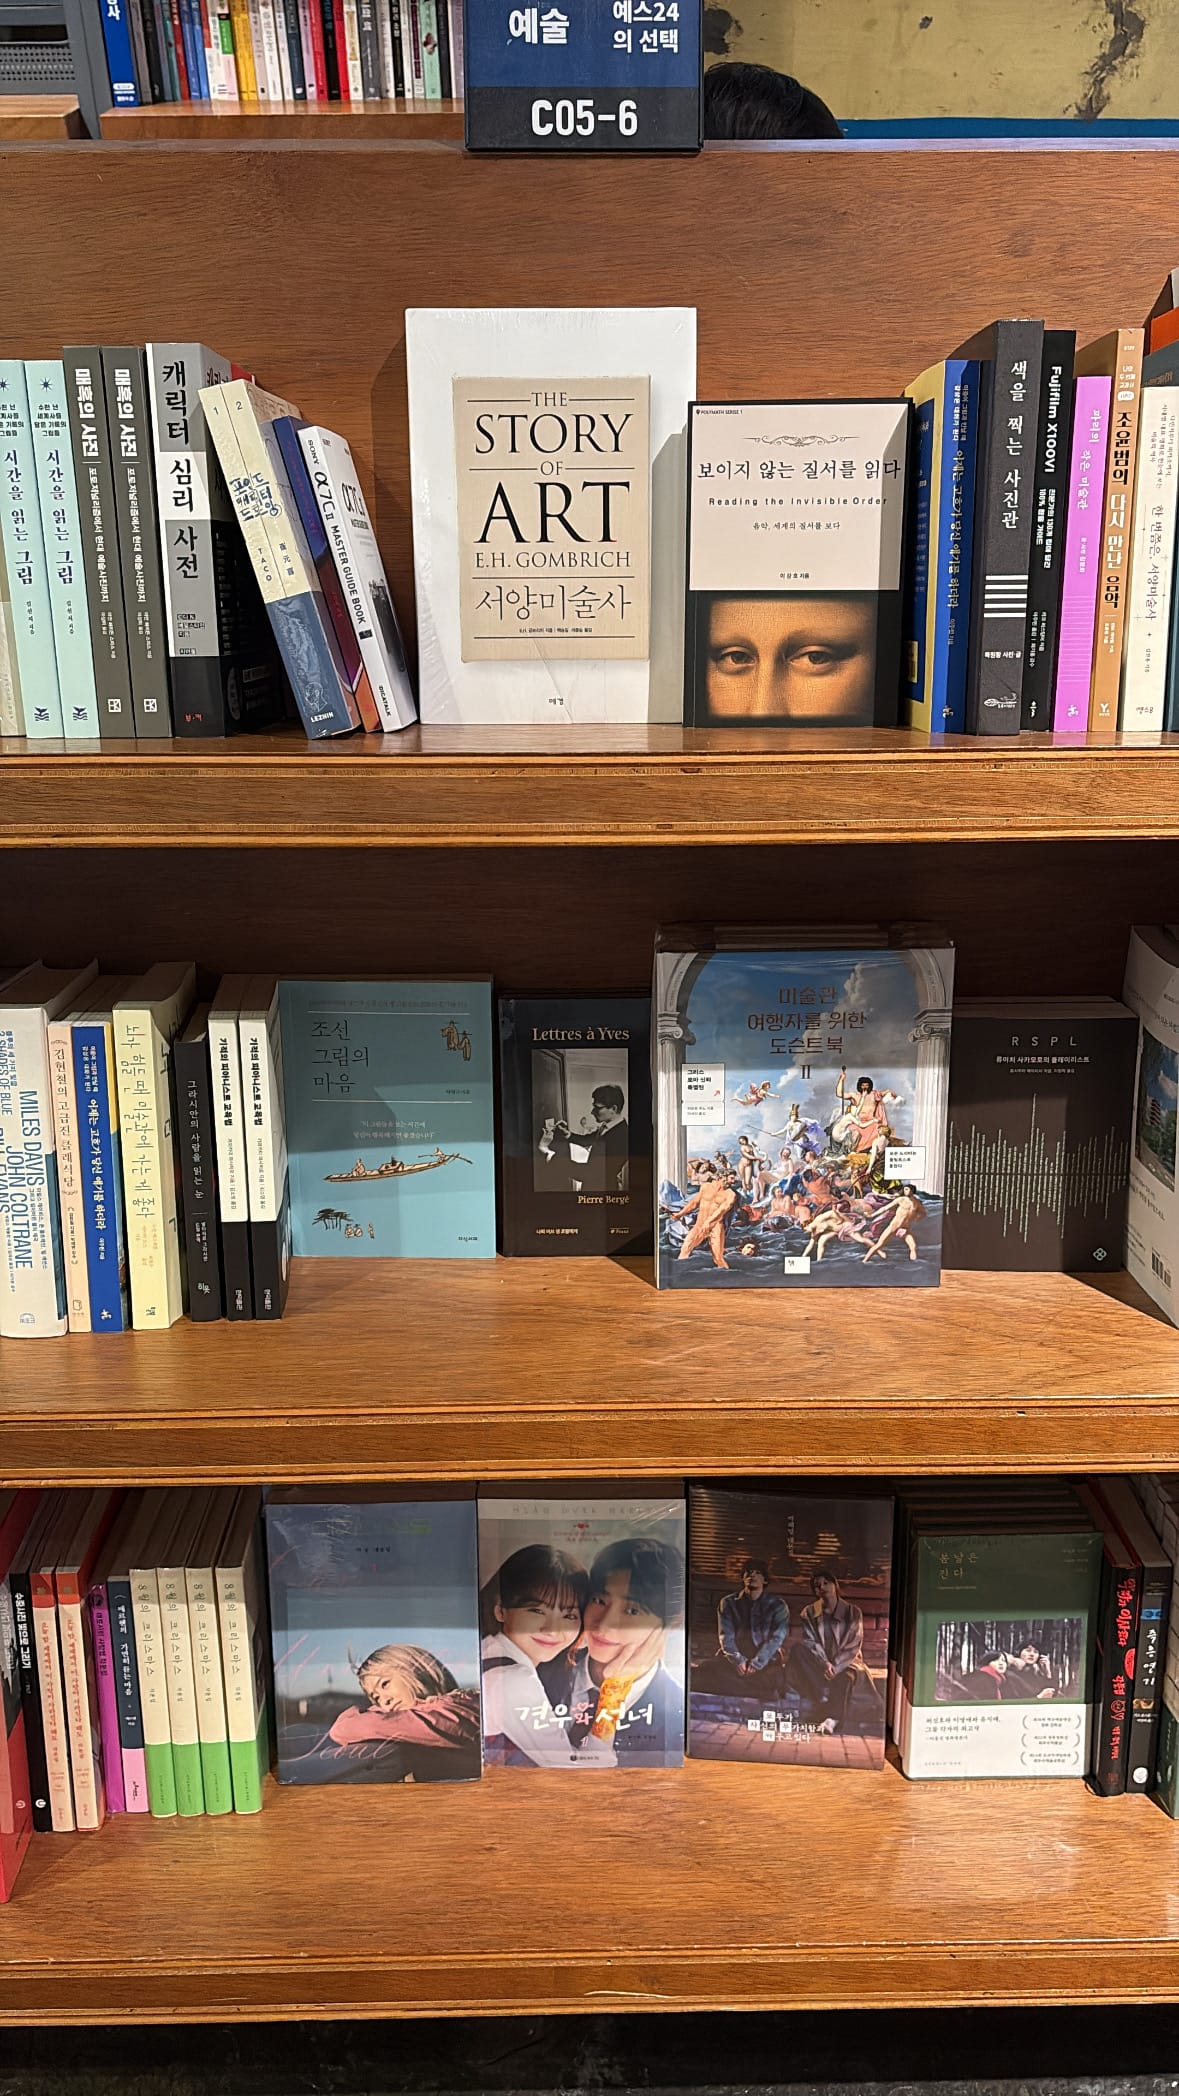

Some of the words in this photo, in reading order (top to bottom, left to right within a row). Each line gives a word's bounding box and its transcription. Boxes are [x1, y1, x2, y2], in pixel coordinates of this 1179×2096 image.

[509, 8, 569, 45] 예술
[612, 1, 680, 23] 예스24
[613, 28, 632, 54] 의
[639, 28, 679, 54] 선택
[531, 99, 638, 136] C05-6
[75, 367, 96, 418] 매혹의
[114, 367, 135, 418] 매혹의
[1010, 359, 1028, 402] 색을
[1046, 365, 1062, 420] Fujifilm
[162, 360, 189, 445] 캐릭터
[236, 401, 243, 410] 2
[531, 392, 568, 407] THE
[80, 424, 99, 458] 사진
[119, 424, 138, 458] 사진
[474, 413, 634, 454] STORY
[1006, 415, 1023, 456] 찍는
[1089, 409, 1101, 443] 파리의
[1043, 422, 1059, 474] X100VI
[1112, 411, 1134, 486] 조윤범의
[4, 449, 24, 500] 시간을
[46, 449, 66, 500] 시간을
[540, 460, 564, 476] OF
[697, 459, 751, 481] 보이지
[759, 459, 795, 480] 않는
[802, 459, 857, 480] 질서를
[864, 459, 902, 480] 읽다
[169, 458, 194, 513] 심리
[1001, 469, 1020, 530] 사진관
[1077, 477, 1090, 510] 미술관
[473, 480, 631, 544] ART
[708, 497, 758, 506] Reading
[765, 497, 784, 505] the
[791, 497, 848, 505] Invisible
[852, 496, 888, 505] Order
[1107, 494, 1126, 529] 다시
[1151, 504, 1164, 518] 한
[11, 509, 28, 541] 읽는
[53, 509, 70, 541] 읽는
[307, 439, 319, 465] SONY
[331, 525, 350, 565] MASTER
[343, 566, 358, 596] GUIDE
[351, 596, 366, 625] BOOK
[825, 521, 840, 530] 보다
[949, 520, 962, 541] 당신
[15, 550, 34, 585] 그림
[56, 550, 74, 585] 그림
[173, 526, 199, 579] 사전
[257, 547, 273, 582] TACO
[475, 552, 511, 568] E.H.
[516, 551, 631, 569] GOMBRICH
[1106, 535, 1124, 570] 만난
[475, 583, 632, 621] 서양미술사
[947, 577, 961, 608] 하더라
[1103, 574, 1120, 609] 음악
[1144, 563, 1162, 621] 서양미술사
[310, 711, 334, 723] LEZHIN
[778, 986, 838, 1004] 미술관
[311, 1019, 350, 1041] 조선
[532, 1027, 583, 1042] Lettres
[587, 1027, 594, 1041] à
[599, 1027, 630, 1041] Yves
[747, 1010, 823, 1031] 여행자를
[827, 1010, 867, 1031] 위한
[121, 1024, 146, 1049] 뇌가
[219, 1038, 232, 1061] 기적의
[249, 1038, 261, 1061] 기적의
[769, 1036, 845, 1055] 도슨트북
[121, 1054, 146, 1076] 힘들
[312, 1046, 369, 1068] 그림의
[996, 1055, 1016, 1063] 류이치
[1017, 1055, 1050, 1063] 사카모토의
[1051, 1055, 1090, 1063] 플레이리스트
[0, 1078, 10, 1090] OF
[53, 1048, 68, 1098] 김현철의
[124, 1080, 151, 1094] 땐
[221, 1063, 234, 1101] 피아니스트
[251, 1063, 263, 1101] 피아니스트
[312, 1072, 357, 1095] 마음
[1, 1093, 13, 1116] BLUE
[19, 1090, 41, 1137] MILES
[58, 1102, 72, 1135] 고급진
[87, 1098, 99, 1126] 어제는
[187, 1080, 199, 1128] 그라시안의
[223, 1103, 235, 1126] 교육법
[252, 1103, 264, 1126] 교육법
[126, 1101, 154, 1149] 미술관에
[90, 1128, 102, 1155] 고흐가
[190, 1133, 203, 1163] 사람을
[5, 1145, 27, 1187] JOHN
[23, 1141, 45, 1186] DAVIS
[91, 1157, 103, 1174] 당신
[131, 1153, 152, 1175] 가는
[92, 1176, 105, 1202] 얘기를
[136, 1179, 153, 1191] 게
[132, 1196, 156, 1219] 좋다
[577, 1194, 604, 1205] Pierre
[605, 1194, 630, 1207] Bergé
[10, 1192, 33, 1269] COLTRANE
[95, 1204, 107, 1230] 하더라
[14, 1592, 27, 1622] 수중사진
[137, 1583, 151, 1613] 8월의
[165, 1583, 178, 1613] 8월의
[193, 1583, 207, 1613] 8월의
[224, 1583, 238, 1613] 8월의
[17, 1623, 29, 1645] 빛으로
[142, 1621, 154, 1675] 크리스마스
[170, 1621, 182, 1675] 크리스마스
[198, 1621, 210, 1675] 크리스마스
[229, 1621, 241, 1675] 크리스마스
[20, 1646, 32, 1669] 그리기
[514, 1703, 593, 1731] 견우와
[595, 1704, 654, 1731] 선녀
